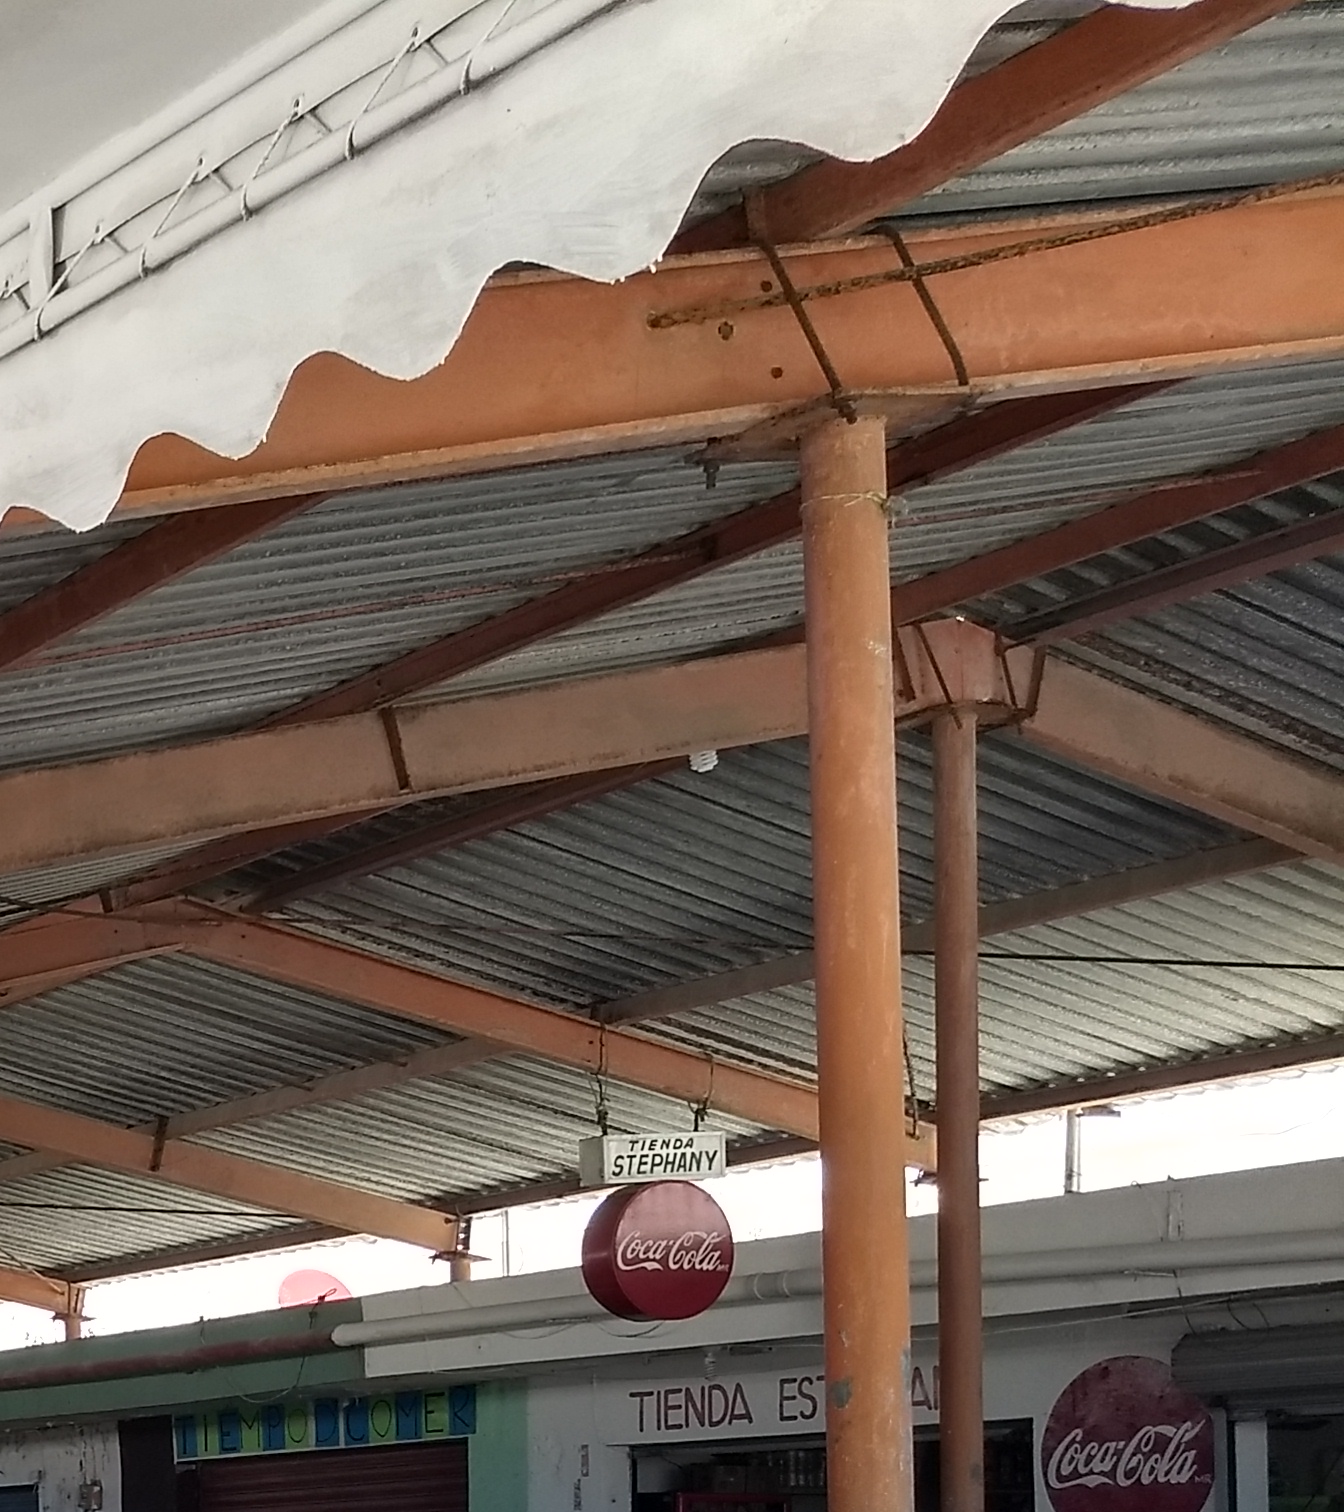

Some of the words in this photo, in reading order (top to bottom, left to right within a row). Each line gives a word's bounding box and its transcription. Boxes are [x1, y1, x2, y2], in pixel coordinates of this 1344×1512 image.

[611, 1149, 719, 1177] STEPHANY
[628, 1137, 694, 1152] TIENDA
[616, 1230, 727, 1272] Coca-Cola
[628, 1381, 753, 1433] TIENDA
[1046, 1419, 1207, 1490] Coca-Cola
